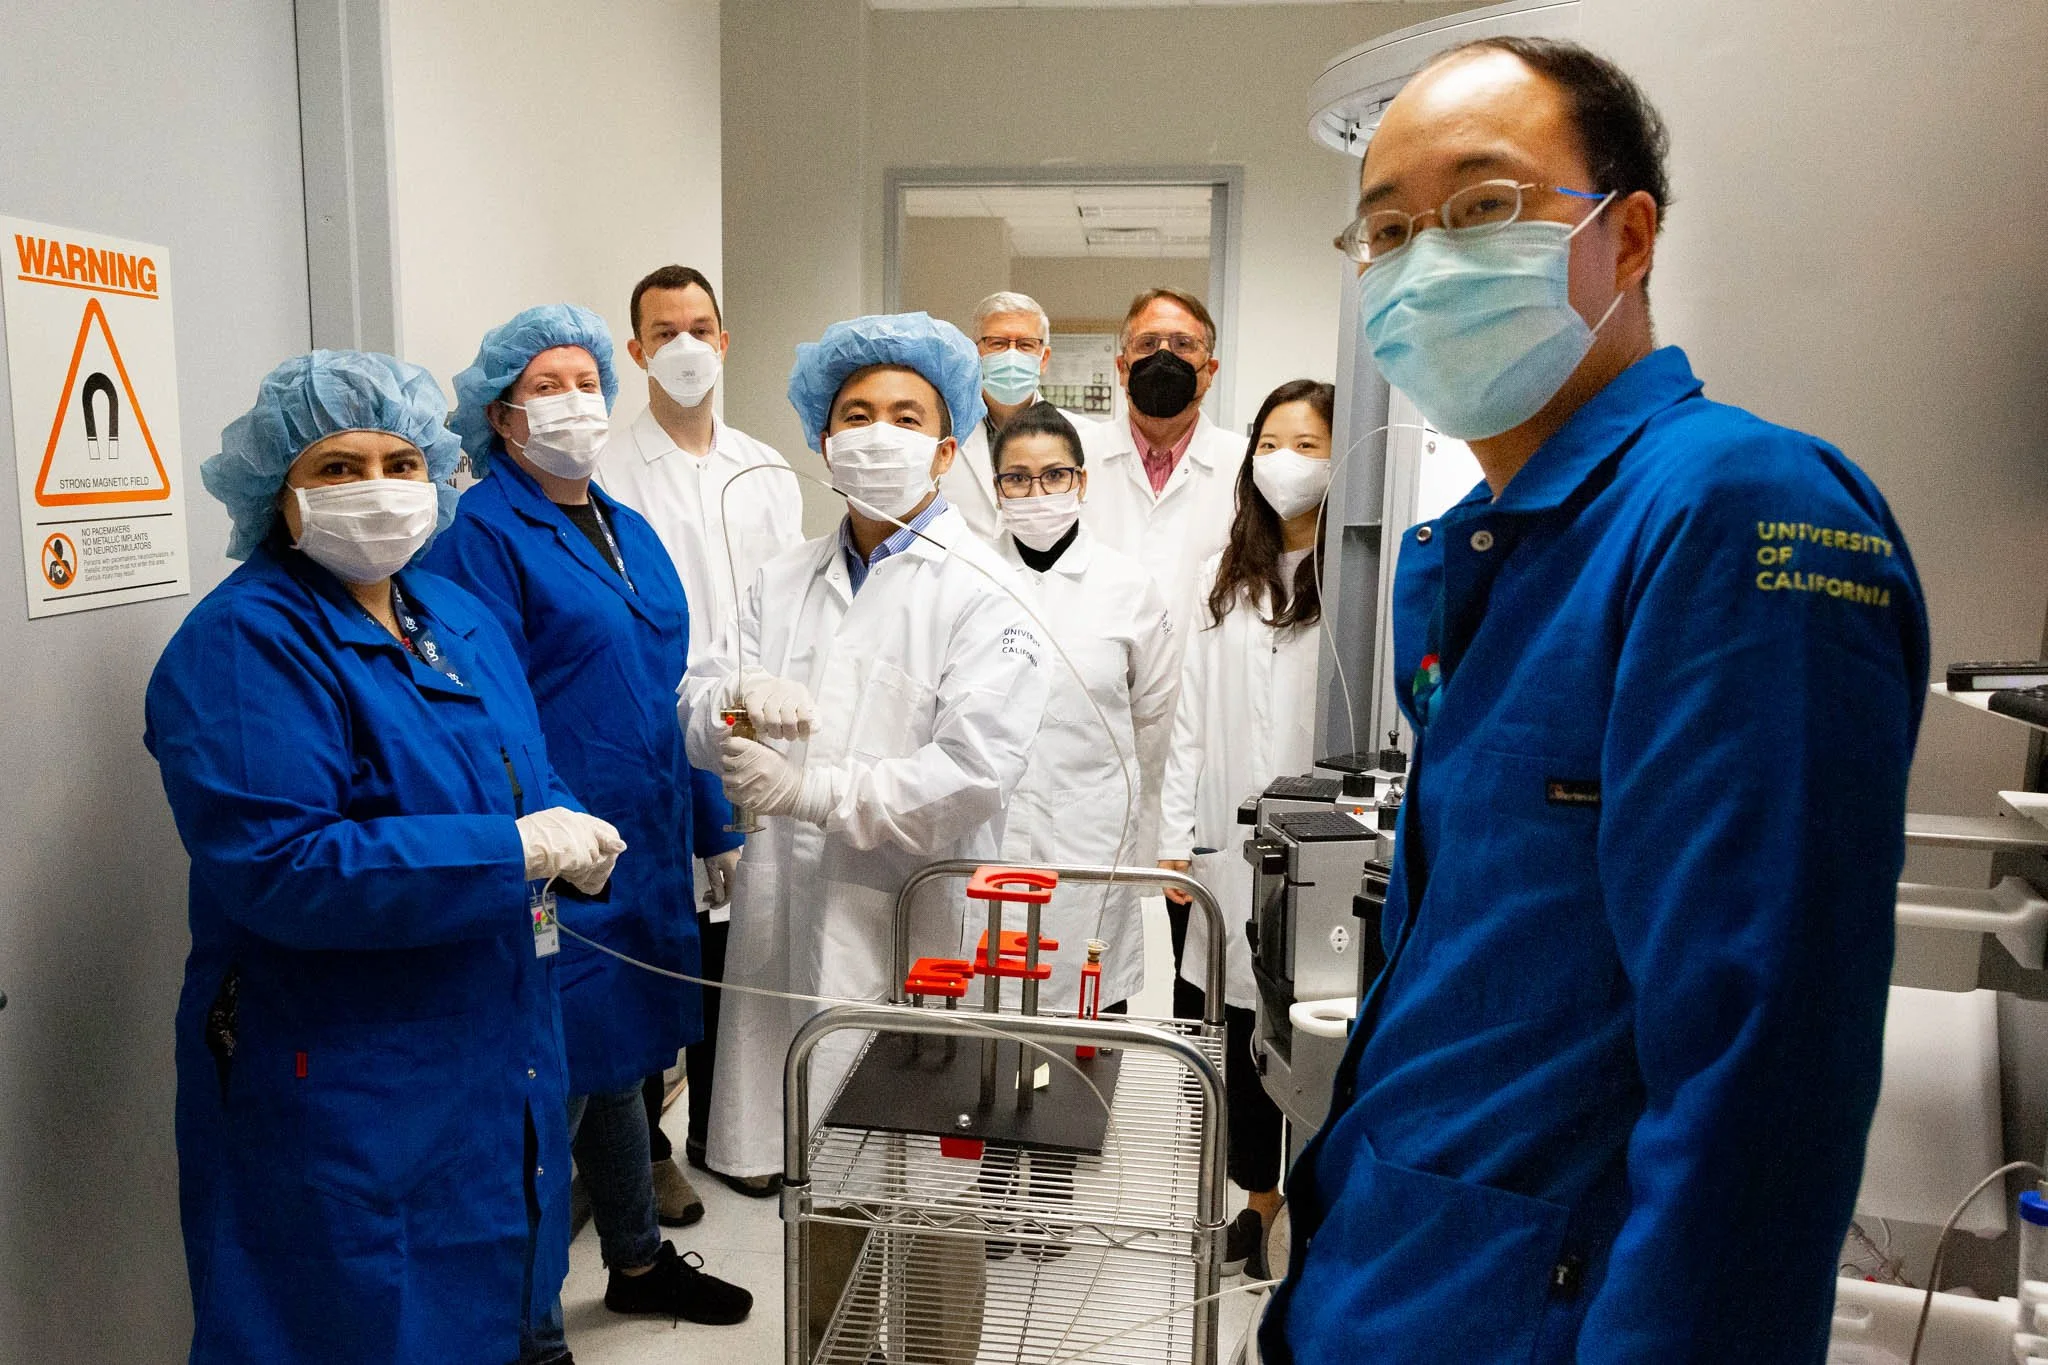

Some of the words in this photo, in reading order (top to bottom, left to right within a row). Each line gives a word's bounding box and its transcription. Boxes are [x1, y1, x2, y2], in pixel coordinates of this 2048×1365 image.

[15, 234, 157, 292] WARNING
[60, 478, 91, 489] STRONG
[92, 477, 129, 488] MAGNETIC
[130, 476, 149, 486] FIELD
[81, 528, 91, 537] NO
[92, 525, 130, 536] PACEMAKERS
[82, 537, 92, 546] NO
[92, 535, 121, 545] METALLIC
[121, 532, 149, 542] IMPLANTS
[1757, 520, 1893, 557] UNIVERSITY
[83, 547, 92, 556] NO
[93, 541, 152, 555] NEUROSTIMULATORS
[1756, 545, 1793, 565] OF
[1755, 570, 1891, 608] CALIFORNIA
[1002, 637, 1015, 645] OF
[424, 640, 439, 662] UCSF
